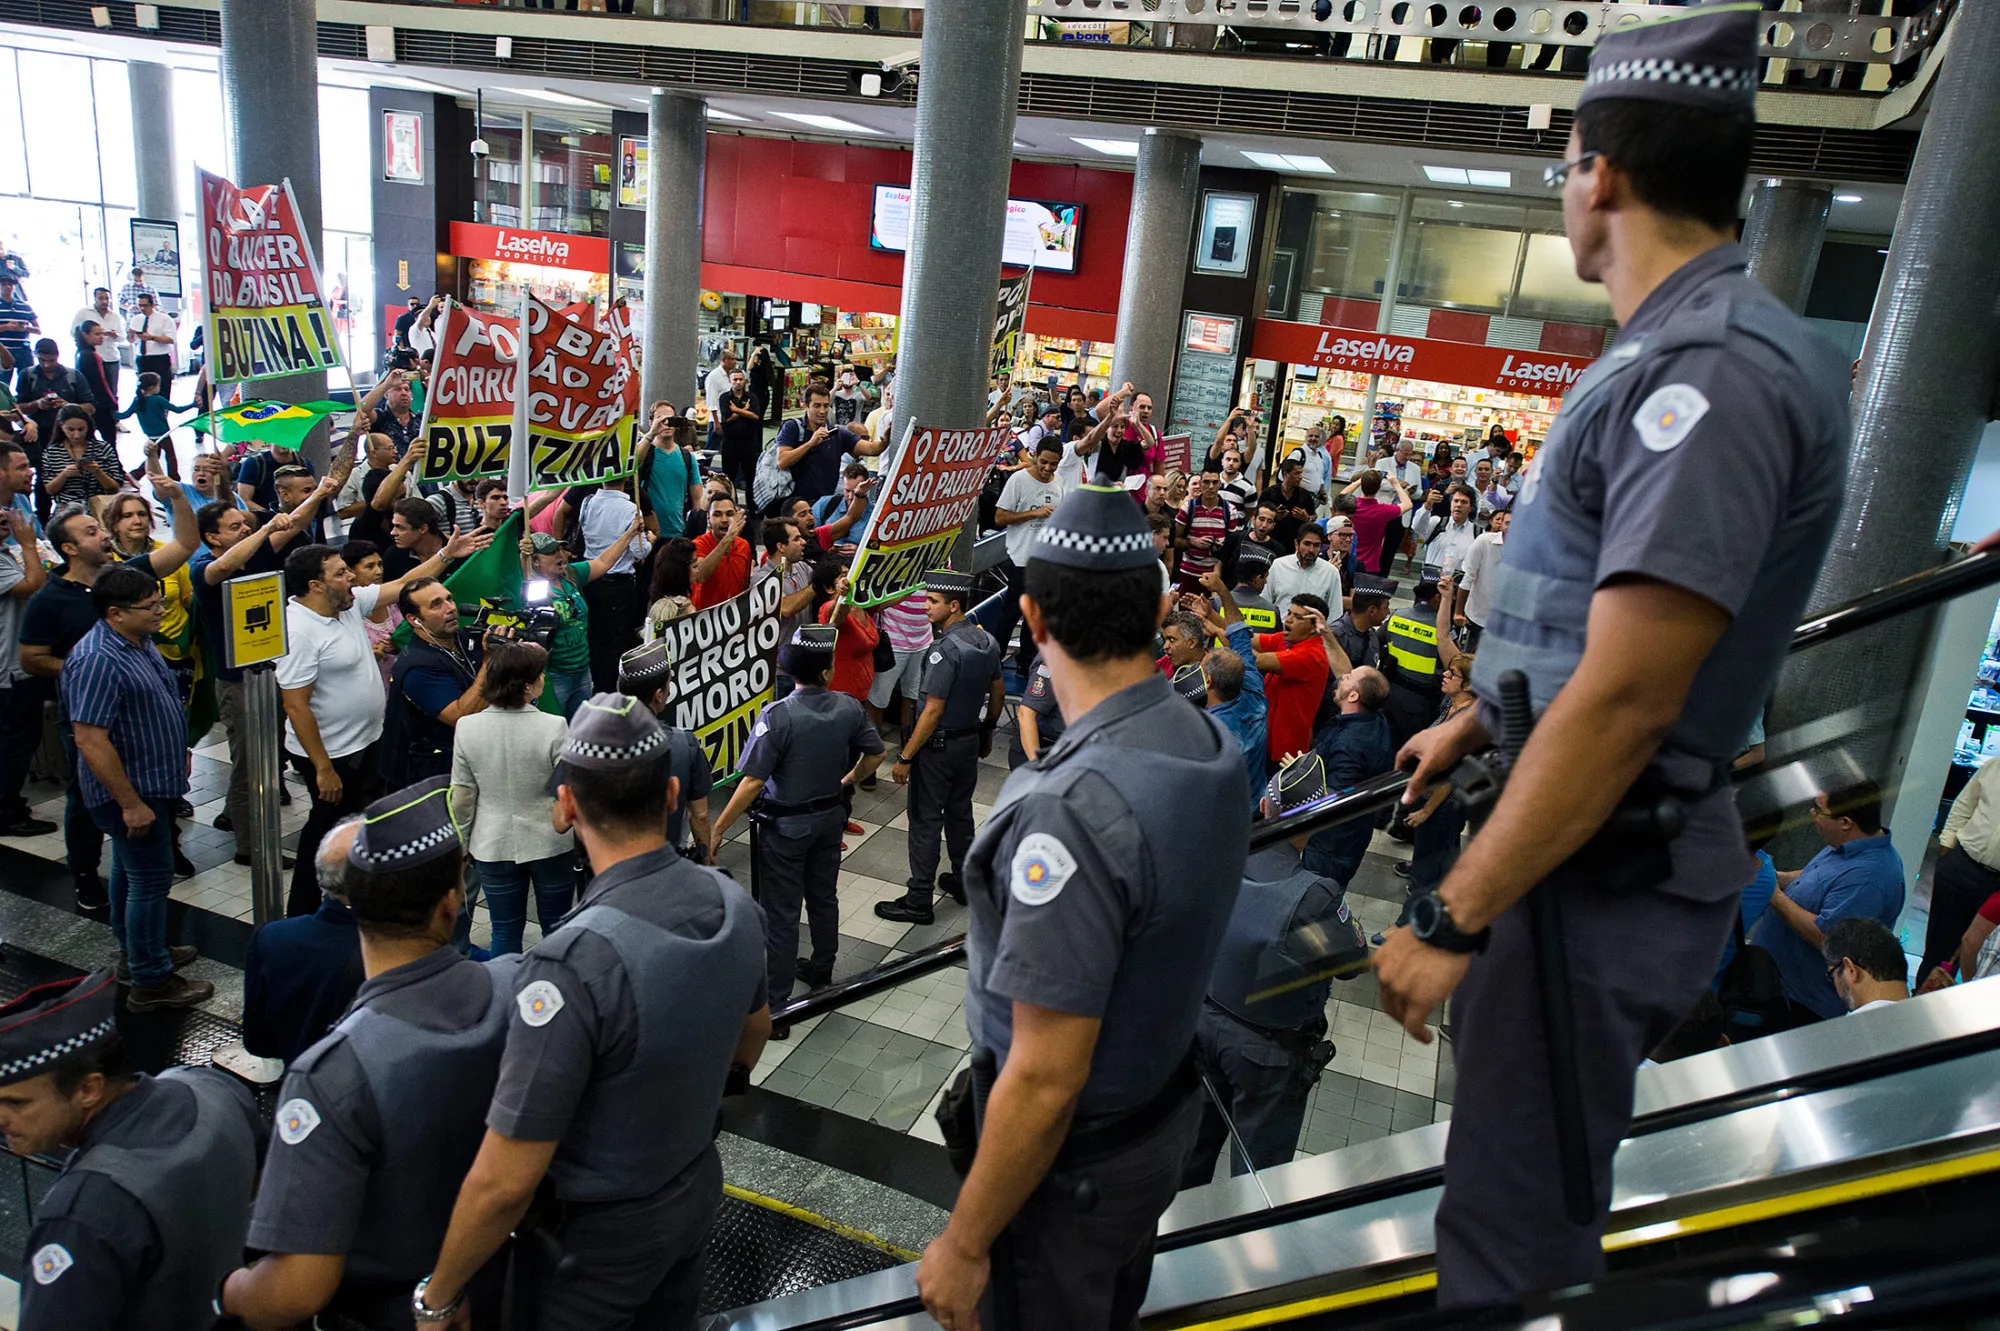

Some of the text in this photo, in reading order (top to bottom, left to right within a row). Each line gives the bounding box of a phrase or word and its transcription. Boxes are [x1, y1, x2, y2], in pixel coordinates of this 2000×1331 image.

[884, 191, 911, 202] Ecolog
[209, 226, 222, 268] O
[494, 250, 568, 265] BOOKSTORE
[496, 231, 569, 257] Laselva
[213, 270, 317, 308] DO BRASIL
[217, 311, 336, 381] BUZINA!
[455, 315, 520, 363] FO
[1315, 331, 1415, 363] Laselva
[529, 349, 590, 388] ÃO
[1312, 354, 1410, 373] BOOKSTORE
[436, 366, 516, 405] CORRU
[1496, 376, 1571, 392] BOOKSTO
[529, 391, 625, 430] CUBA
[423, 423, 511, 480] BUZ
[914, 428, 1008, 465] O FORO DE
[891, 467, 934, 506] SÃO
[931, 467, 982, 501] PAULO
[877, 496, 979, 542] CRIMINOSO
[665, 576, 780, 664] APOIO AO
[664, 616, 780, 704] SERGIO
[675, 658, 769, 732] MORO
